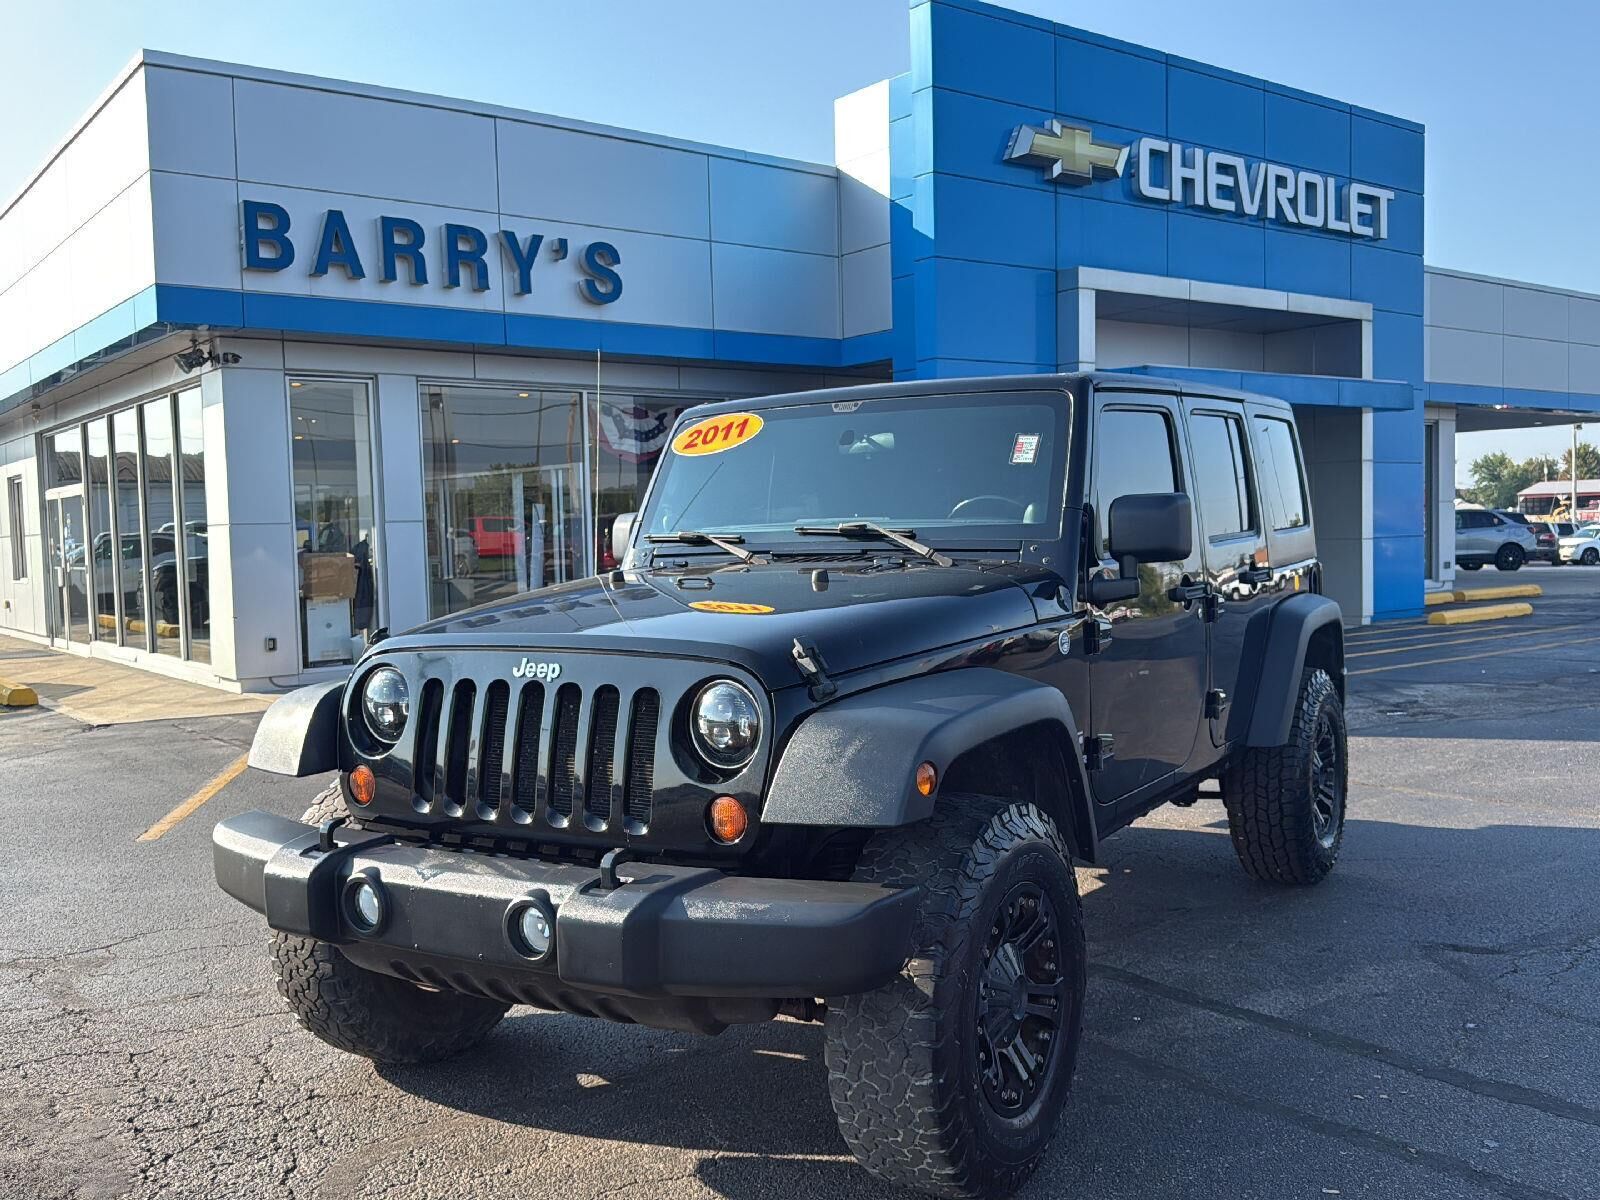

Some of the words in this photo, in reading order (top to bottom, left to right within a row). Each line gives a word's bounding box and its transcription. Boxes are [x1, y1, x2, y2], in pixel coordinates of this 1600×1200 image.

[1135, 137, 1395, 239] CHEVROLET
[241, 199, 623, 305] BARRY'S
[682, 418, 749, 450] 2011
[512, 657, 561, 682] Jeep
